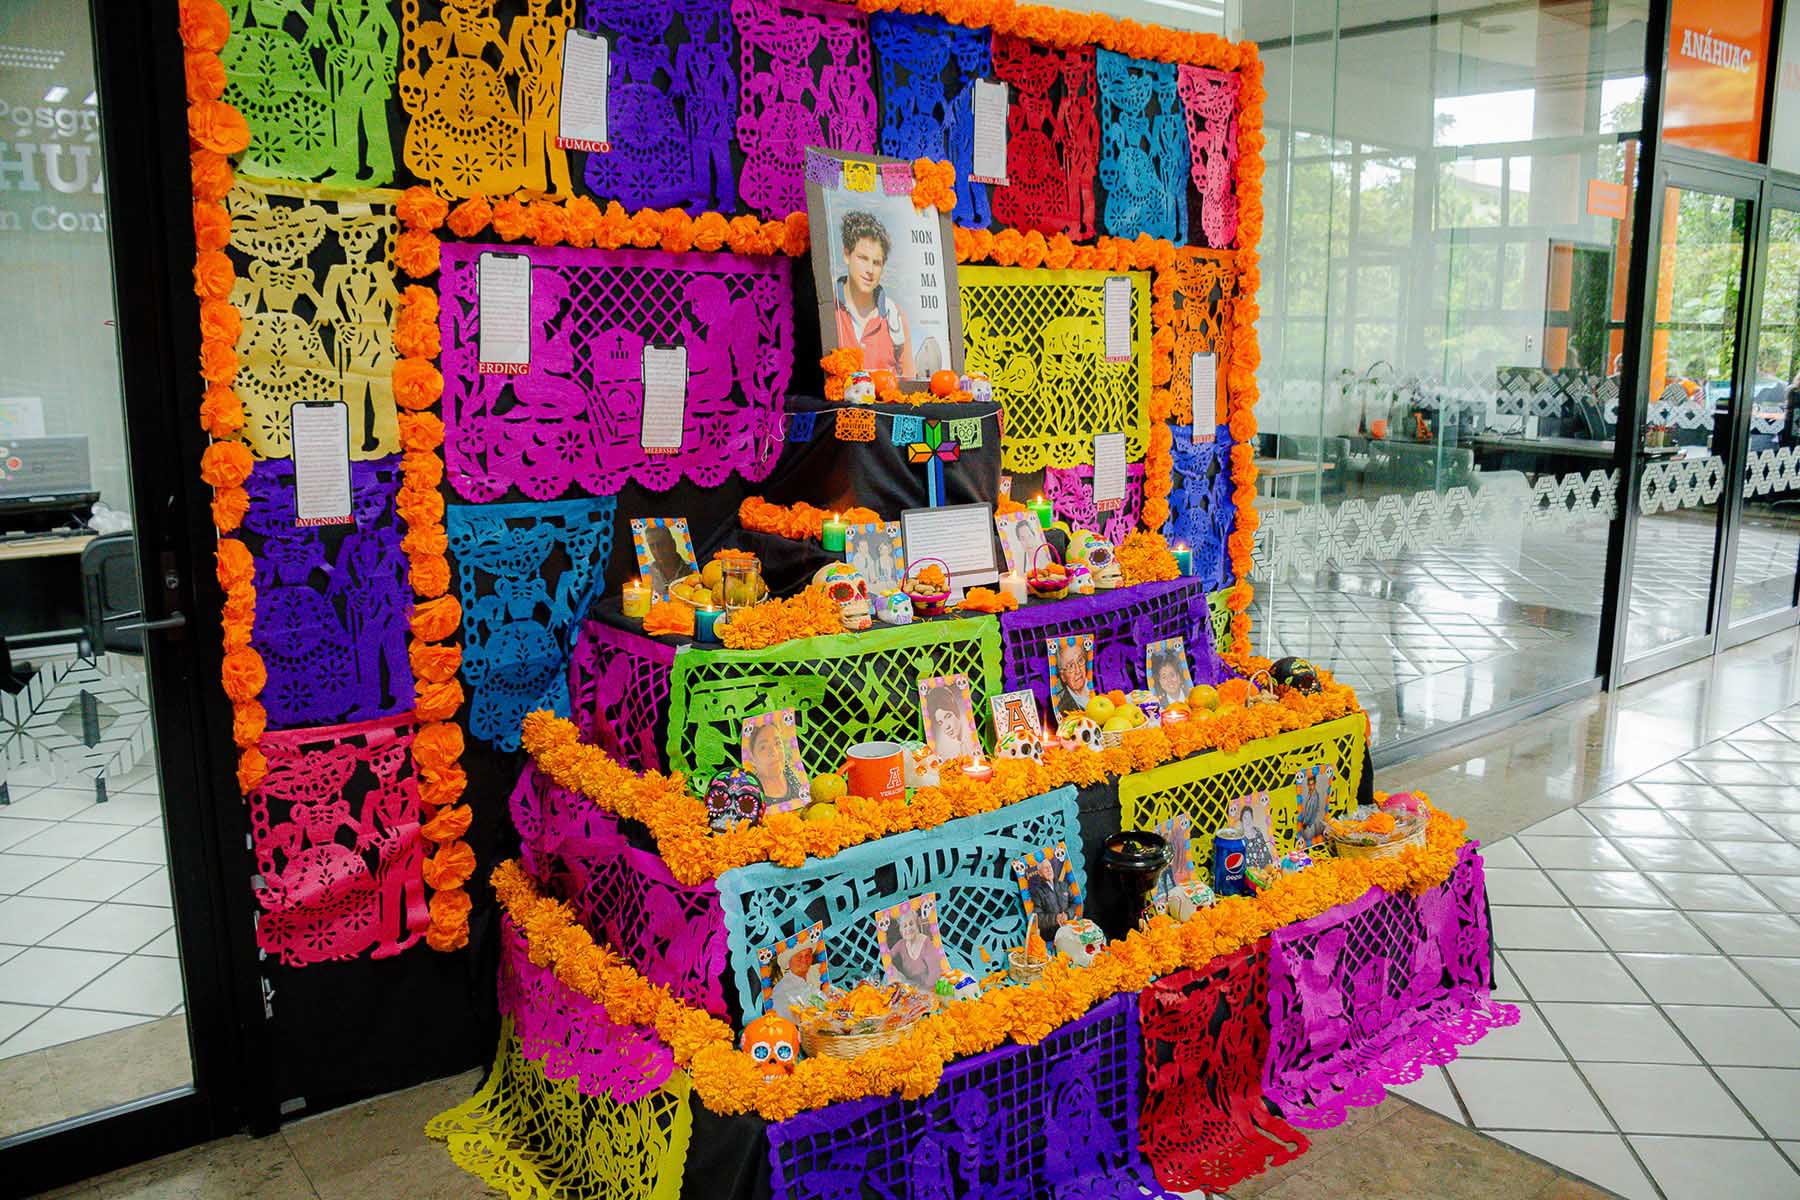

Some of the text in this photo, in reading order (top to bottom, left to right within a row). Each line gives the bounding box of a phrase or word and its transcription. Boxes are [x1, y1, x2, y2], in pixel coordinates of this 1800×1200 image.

[1681, 27, 1752, 73] ANÁHUAC
[558, 137, 611, 153] TUMACO
[0, 142, 104, 193] HU
[31, 204, 105, 233] Con
[912, 230, 933, 244] NON
[920, 273, 937, 288] MA
[921, 295, 938, 309] DIO
[479, 362, 528, 375] ERDING
[297, 515, 350, 528] AVIGNONE
[1005, 699, 1037, 735] A
[886, 766, 902, 790] A
